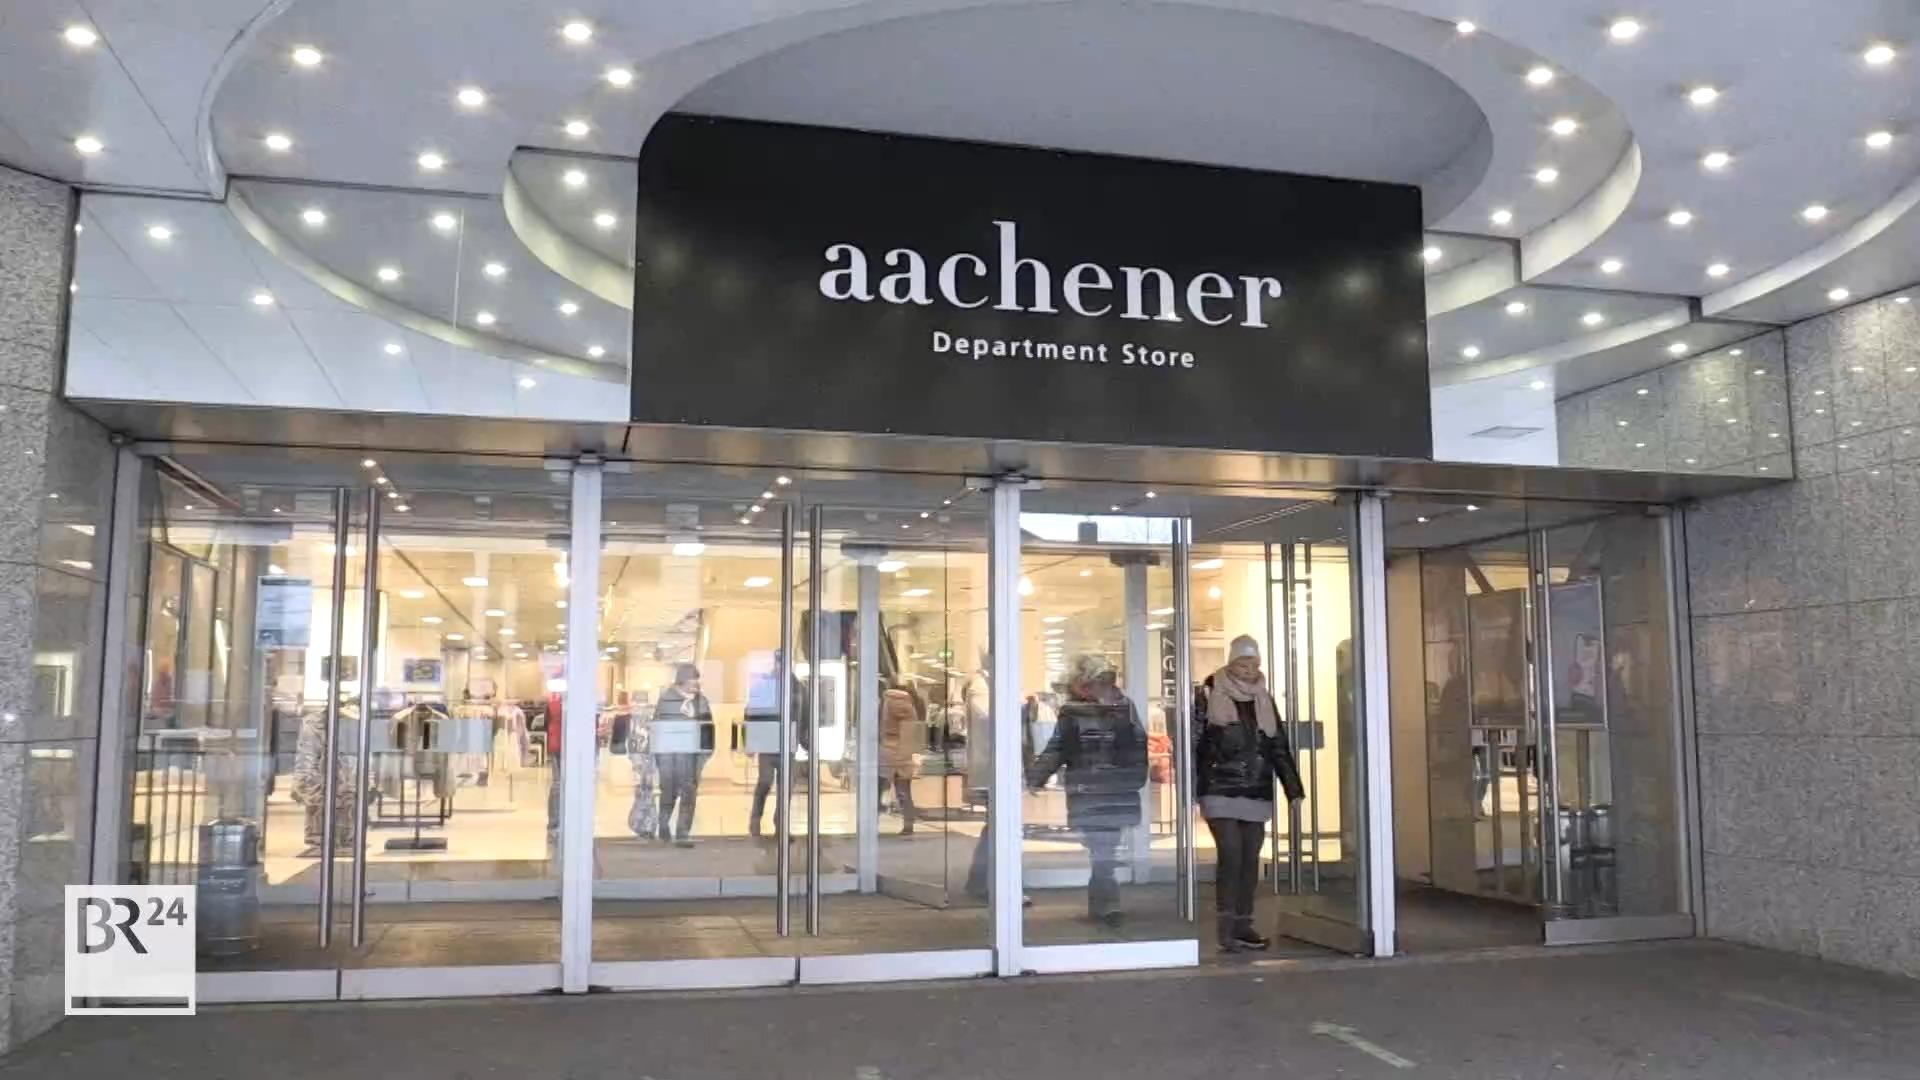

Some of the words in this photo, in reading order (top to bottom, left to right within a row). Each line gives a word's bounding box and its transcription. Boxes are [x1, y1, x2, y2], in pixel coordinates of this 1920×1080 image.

[819, 221, 1282, 328] aachener
[933, 331, 1109, 362] Department
[1122, 343, 1195, 368] Store
